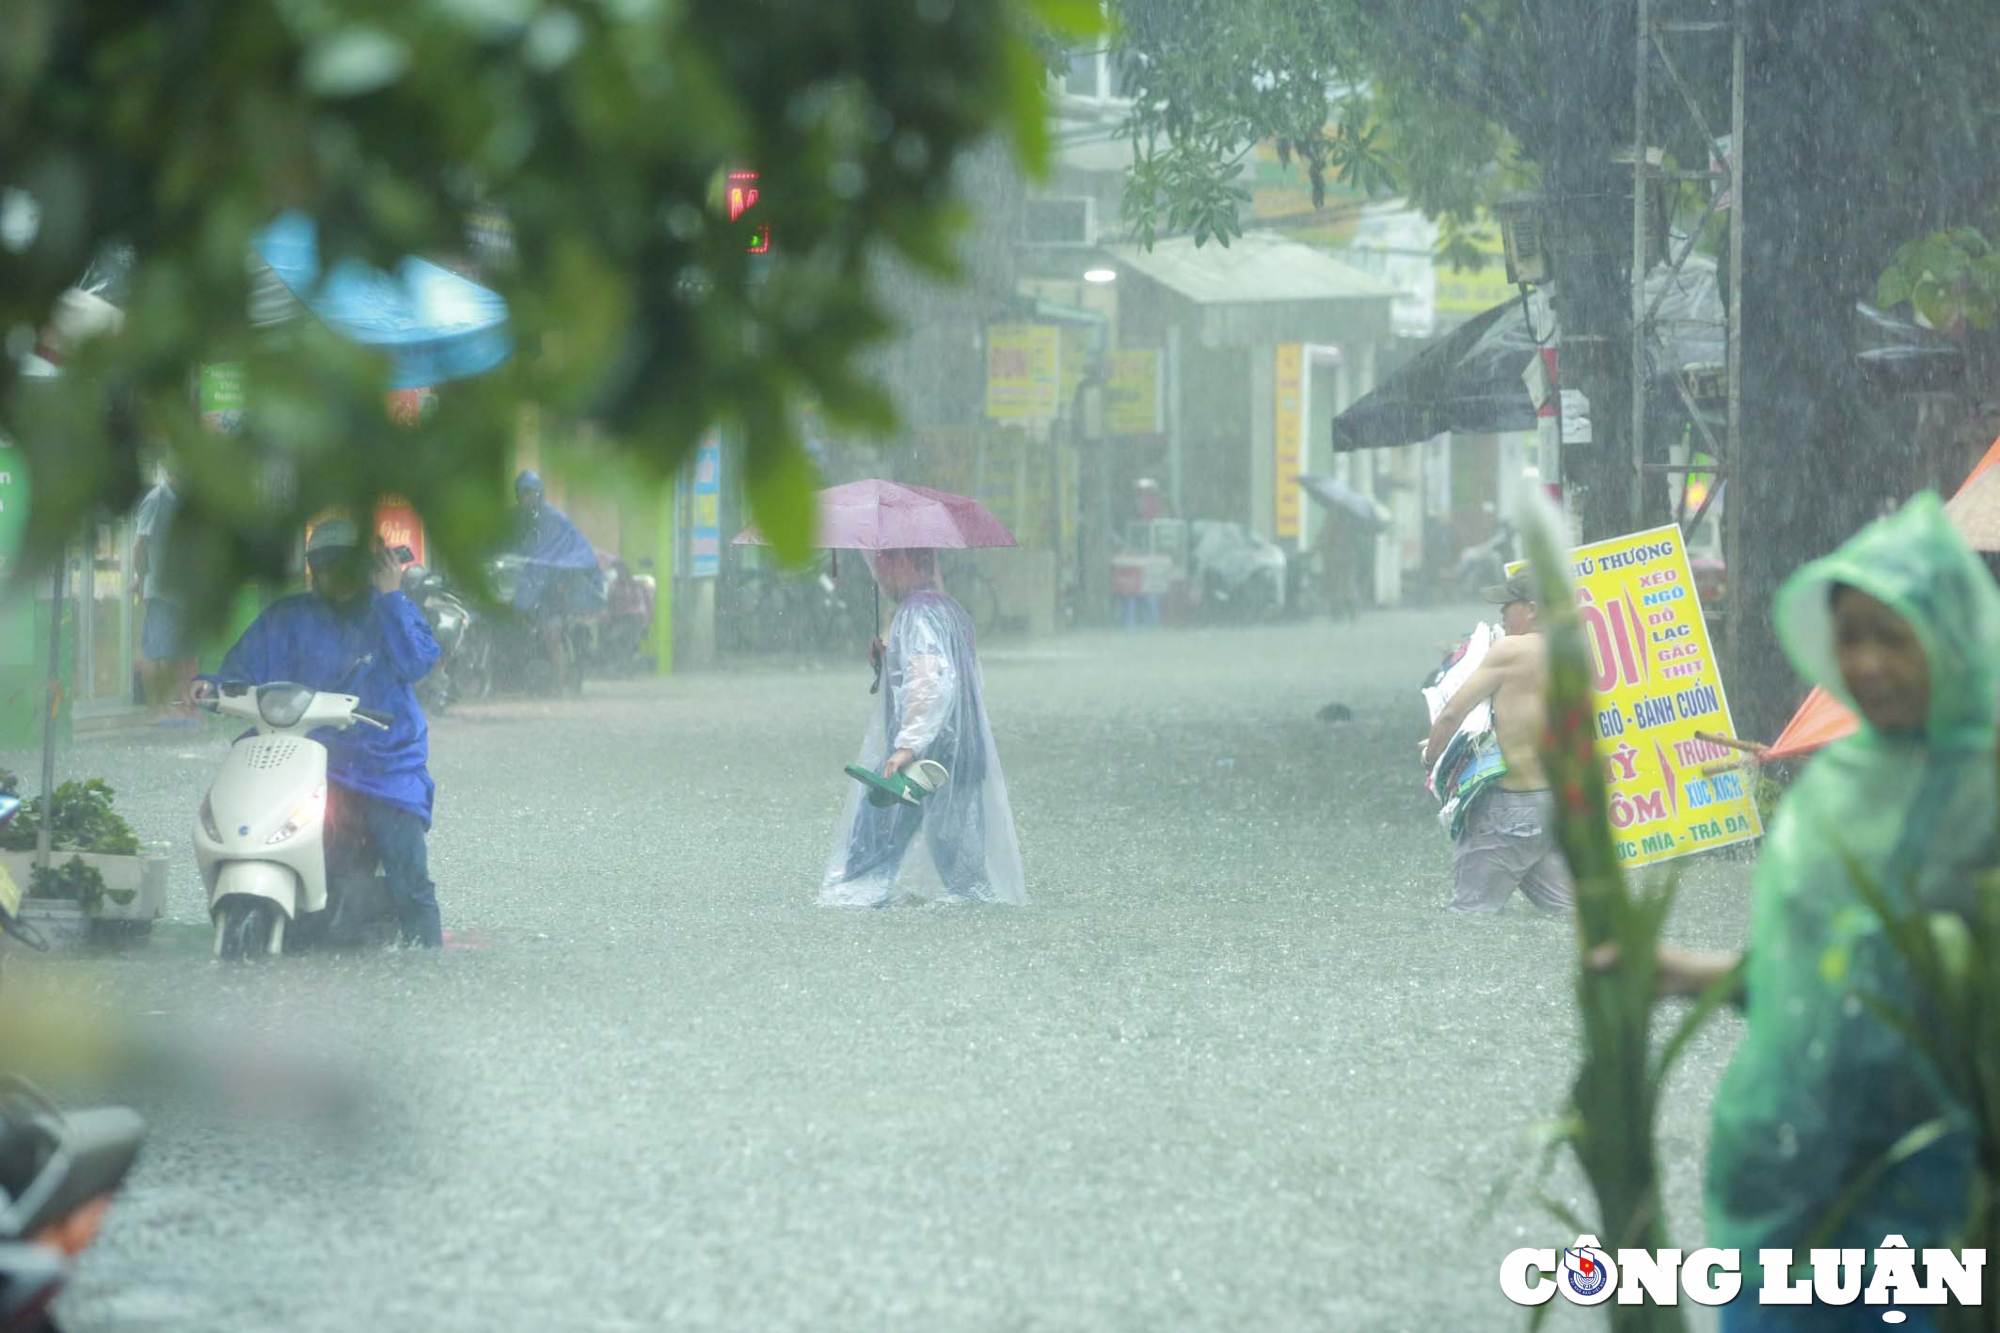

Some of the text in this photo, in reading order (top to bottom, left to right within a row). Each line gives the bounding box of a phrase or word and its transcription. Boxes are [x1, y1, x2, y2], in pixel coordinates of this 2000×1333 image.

[1597, 541, 1674, 572] THƯỢNG
[1642, 585, 1685, 606] NGÔ
[1575, 586, 1640, 693] ÔI
[1652, 624, 1690, 643] LẠC
[1661, 660, 1703, 679] THỊT
[1598, 703, 1625, 738] GIÒ
[1633, 694, 1677, 730] BÁNH
[1676, 677, 1720, 719] CUỐN
[1684, 775, 1712, 808] XÚC
[1608, 789, 1668, 828] ÔM
[1688, 817, 1723, 843] TRÀ
